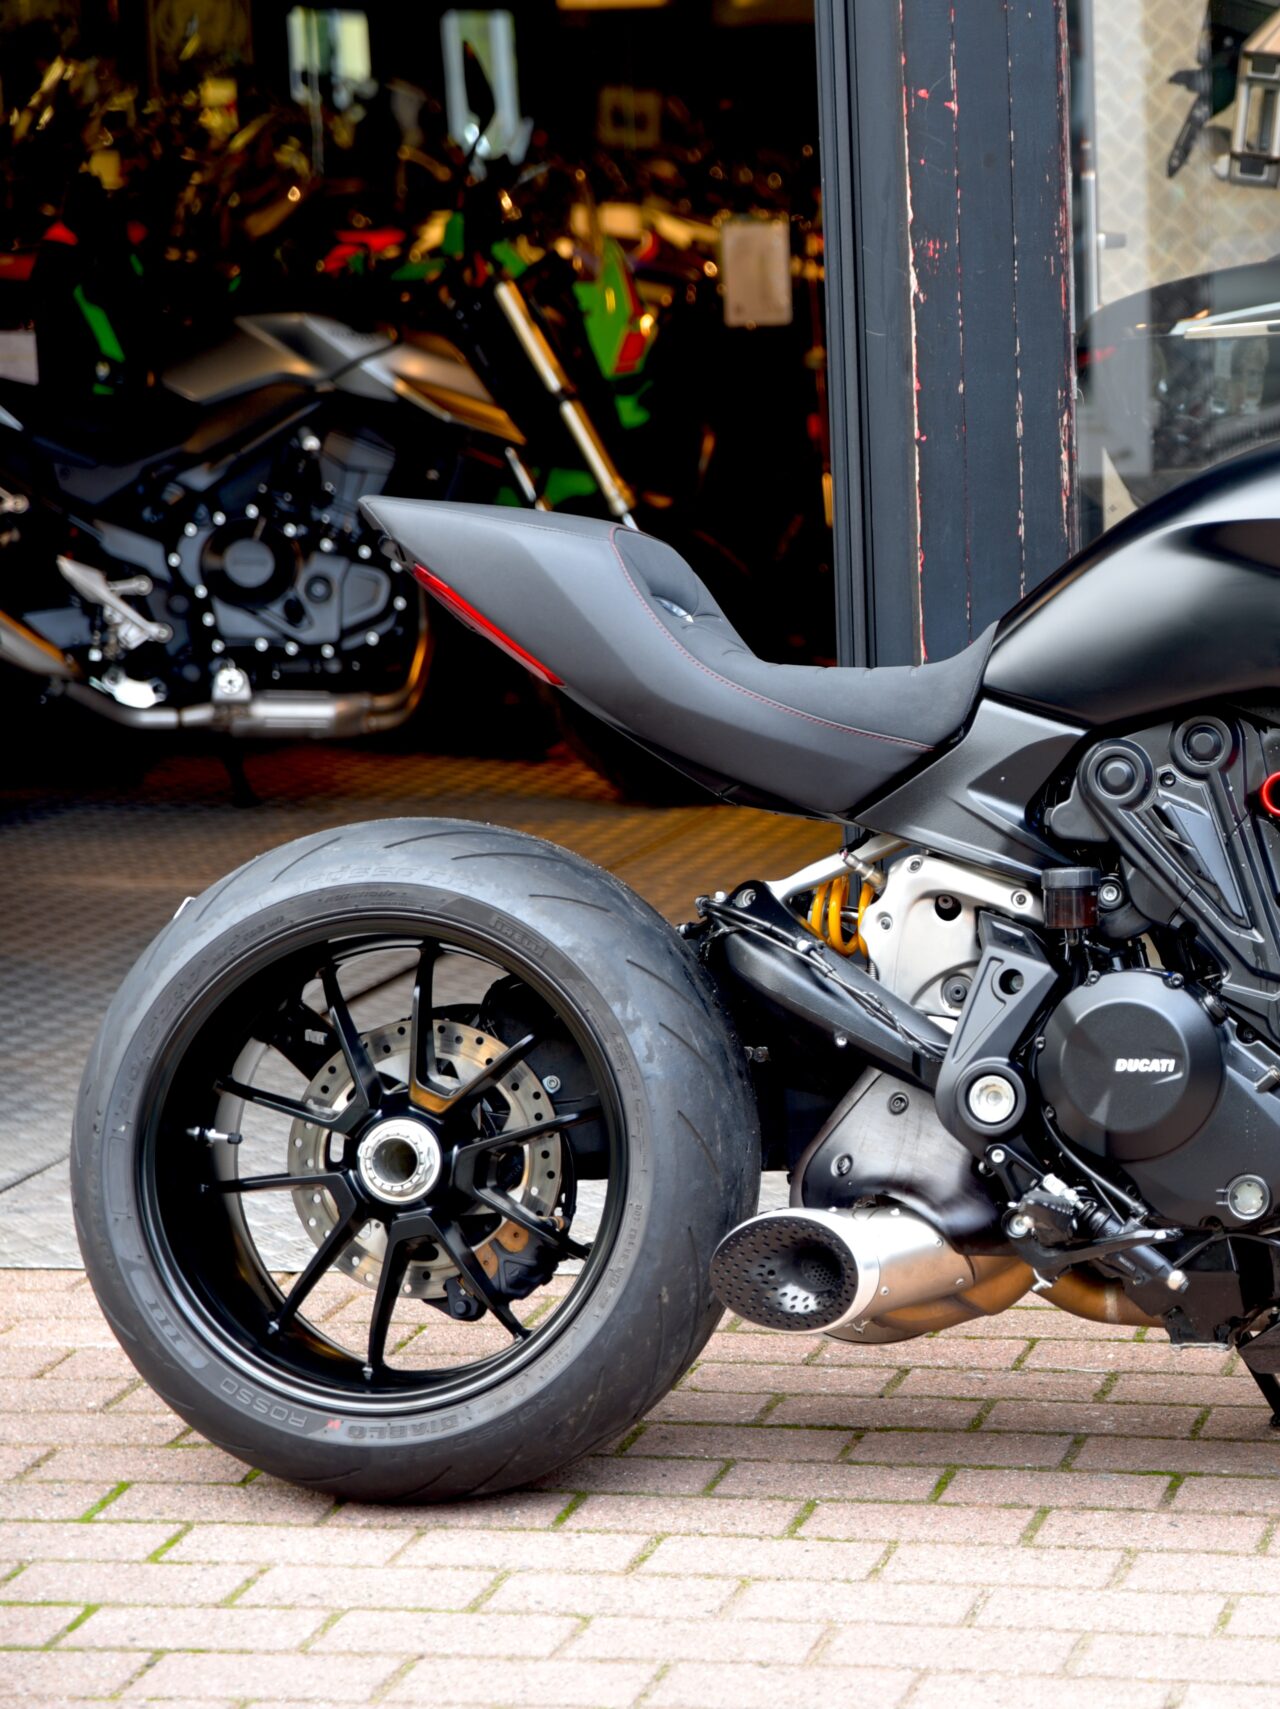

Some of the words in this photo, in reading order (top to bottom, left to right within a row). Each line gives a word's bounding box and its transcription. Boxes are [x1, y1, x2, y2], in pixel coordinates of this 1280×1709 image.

[1115, 1059, 1175, 1072] DUCATI
[220, 1377, 308, 1429] ROSSO
[347, 1413, 460, 1440] DIABLO
